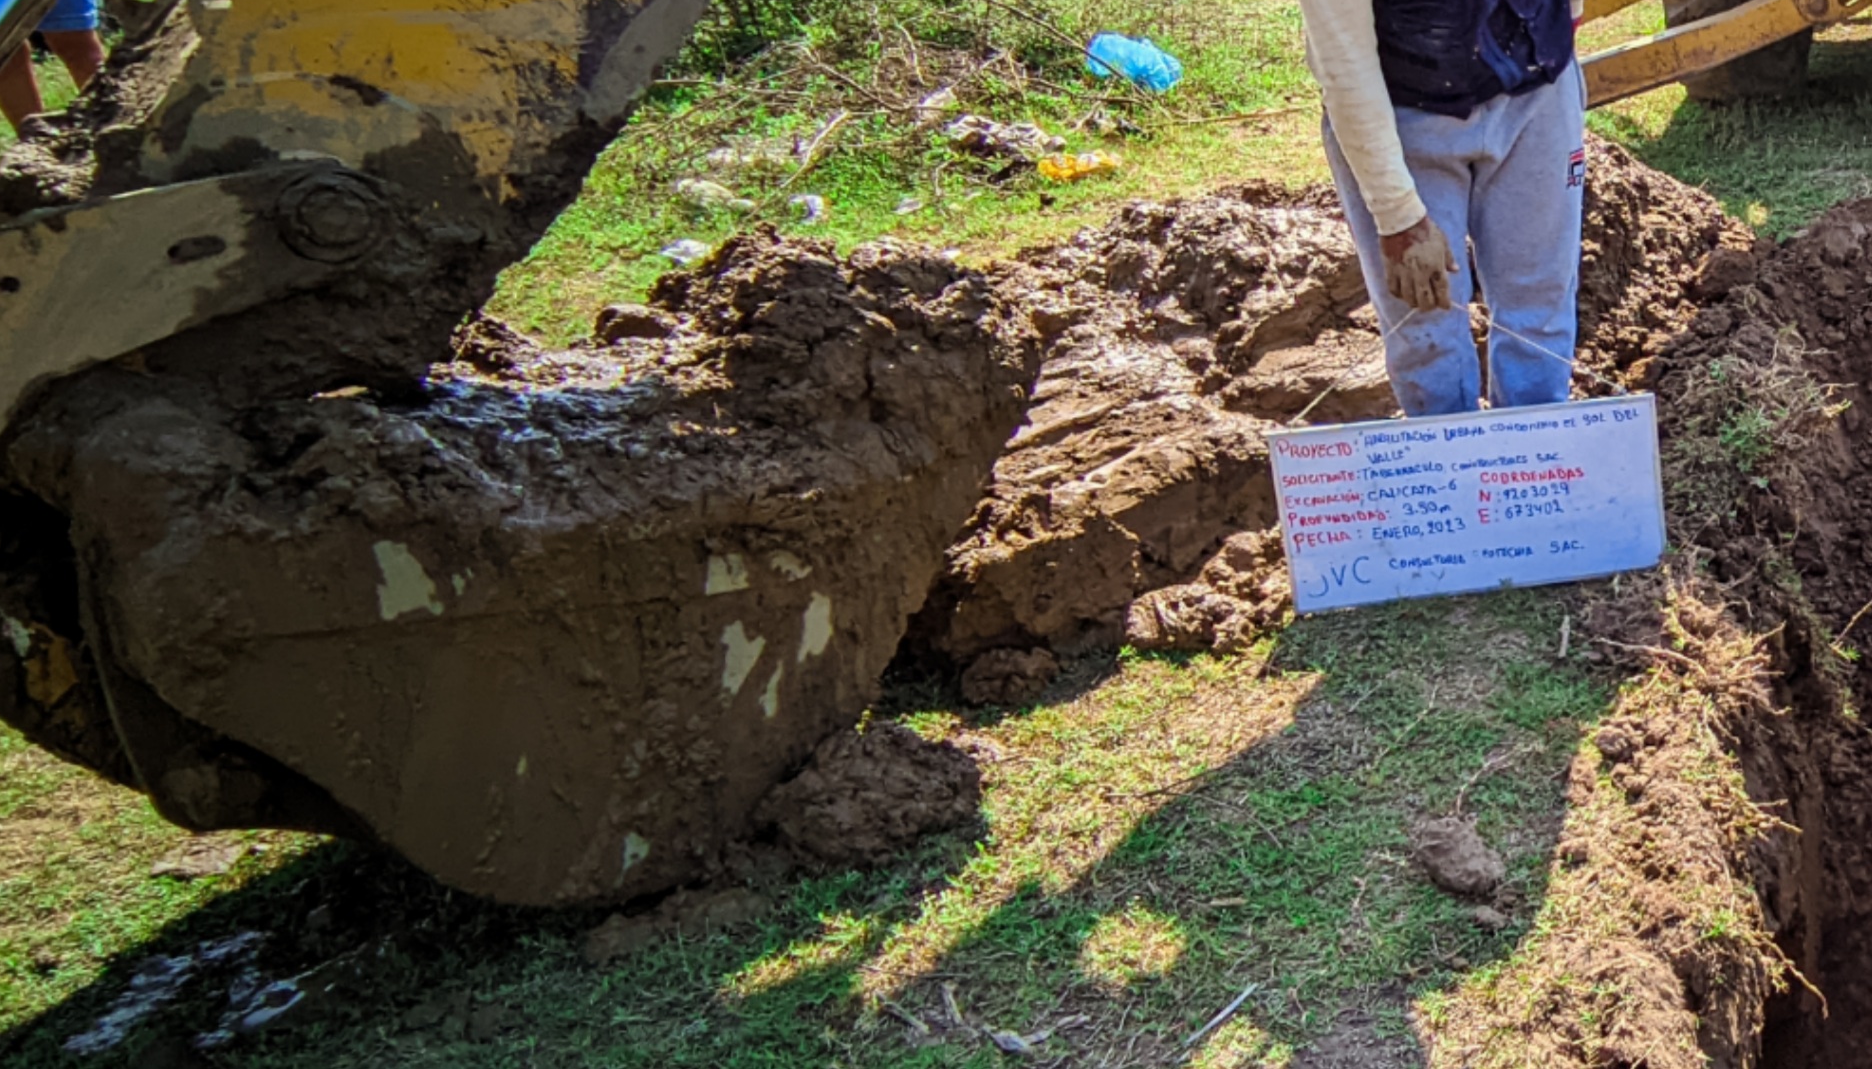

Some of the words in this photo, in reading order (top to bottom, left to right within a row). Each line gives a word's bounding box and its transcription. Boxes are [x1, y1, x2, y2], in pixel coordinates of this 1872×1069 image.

[1582, 412, 1606, 426] SOL
[1613, 408, 1640, 422] DEL
[1480, 466, 1585, 485] COORDENADAS
[1427, 517, 1466, 534] 2023
[1308, 555, 1371, 598] JVC
